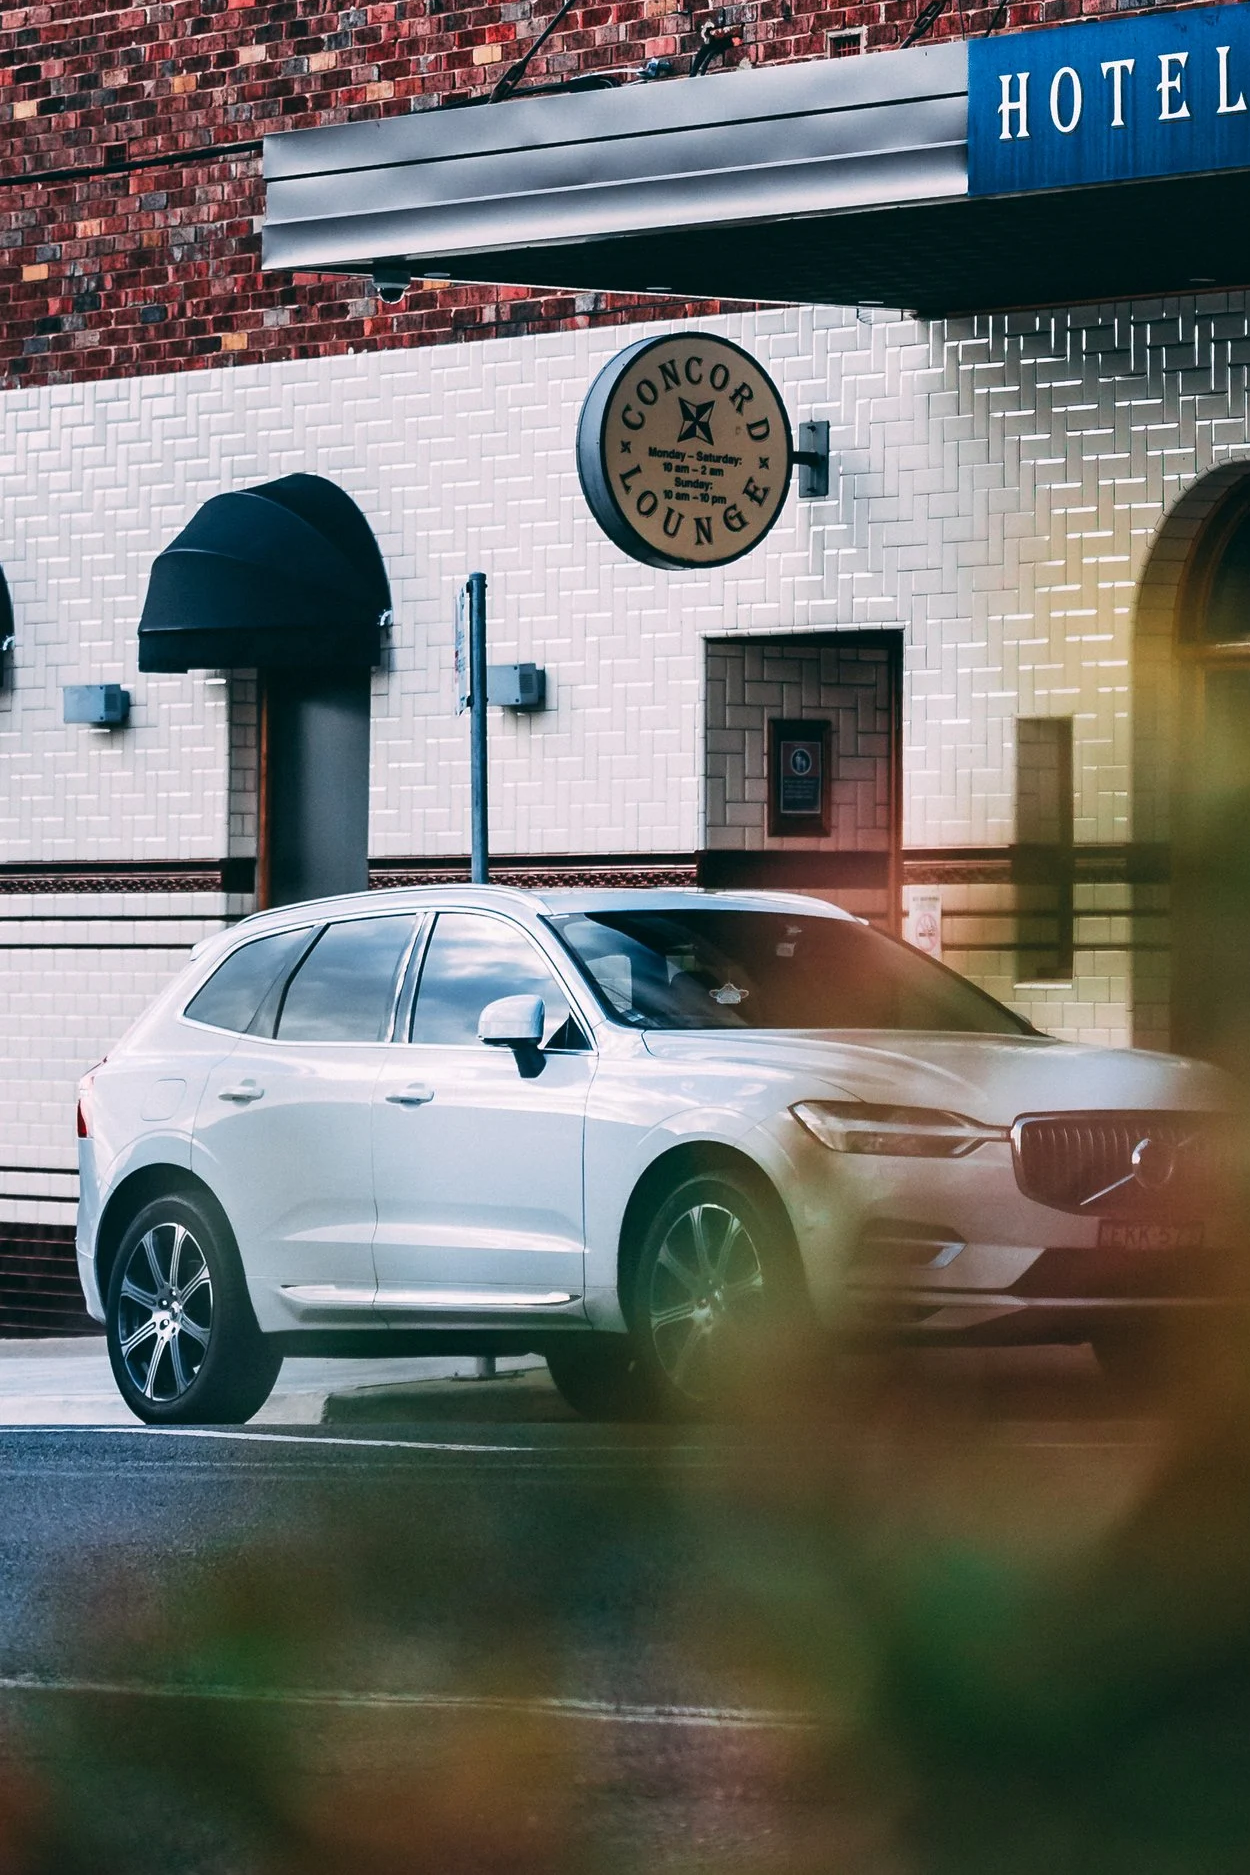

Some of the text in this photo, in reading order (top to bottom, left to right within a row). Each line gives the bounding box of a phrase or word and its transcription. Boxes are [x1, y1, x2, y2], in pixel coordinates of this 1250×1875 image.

[997, 45, 1247, 141] HOTEL
[621, 356, 771, 442] CONCORD
[648, 446, 686, 462] Monday
[696, 450, 742, 467] Saturday:
[662, 462, 673, 473] 10
[675, 464, 690, 474] am
[701, 465, 707, 475] 2
[674, 476, 713, 492] Sunday:
[619, 465, 771, 546] LOUNGE
[663, 489, 673, 500] 10
[675, 492, 690, 501] am
[699, 492, 709, 503] 10
[711, 495, 727, 506] pm
